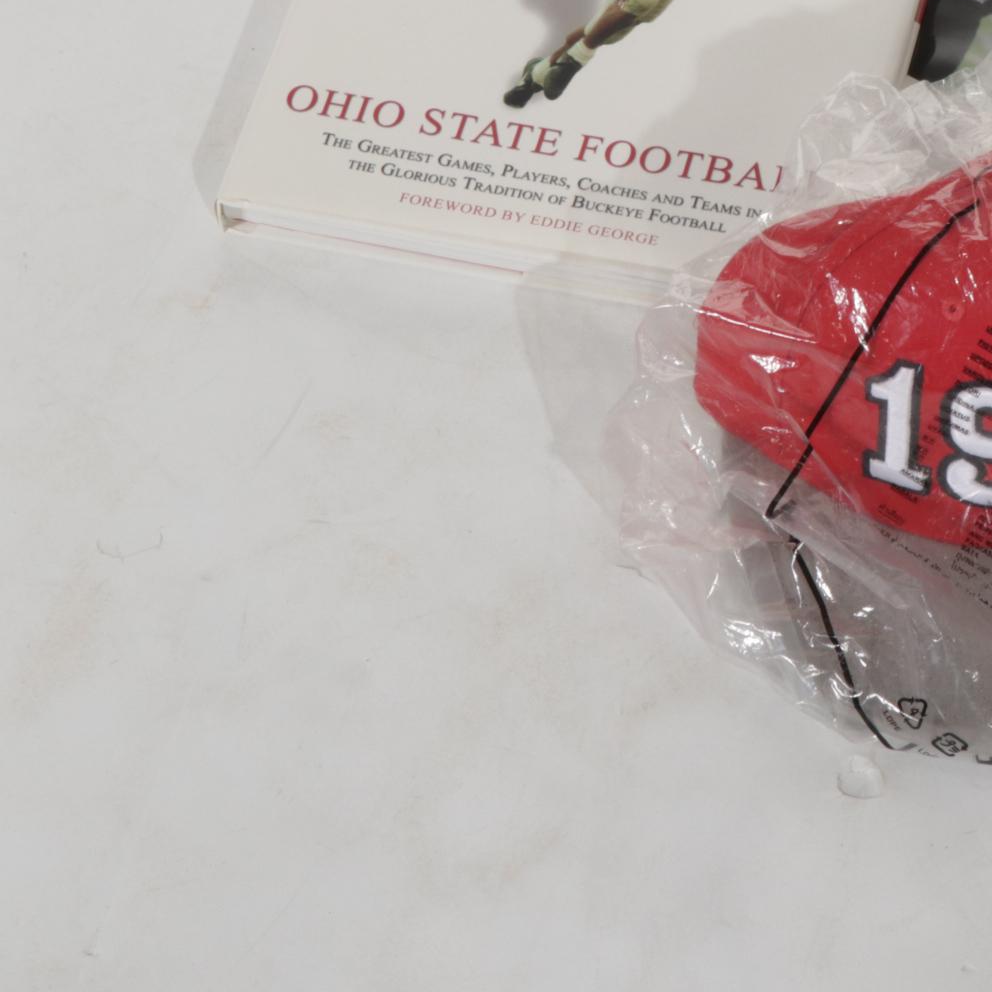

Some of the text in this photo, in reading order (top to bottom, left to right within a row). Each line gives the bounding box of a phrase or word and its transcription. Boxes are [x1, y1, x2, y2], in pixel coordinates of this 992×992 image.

[286, 84, 405, 129] OHIO
[419, 107, 563, 157] STATE
[348, 159, 376, 174] THE
[548, 194, 567, 206] OF
[653, 192, 684, 207] AND
[399, 192, 660, 247] FOREWORD BY EDDIE GEORGE
